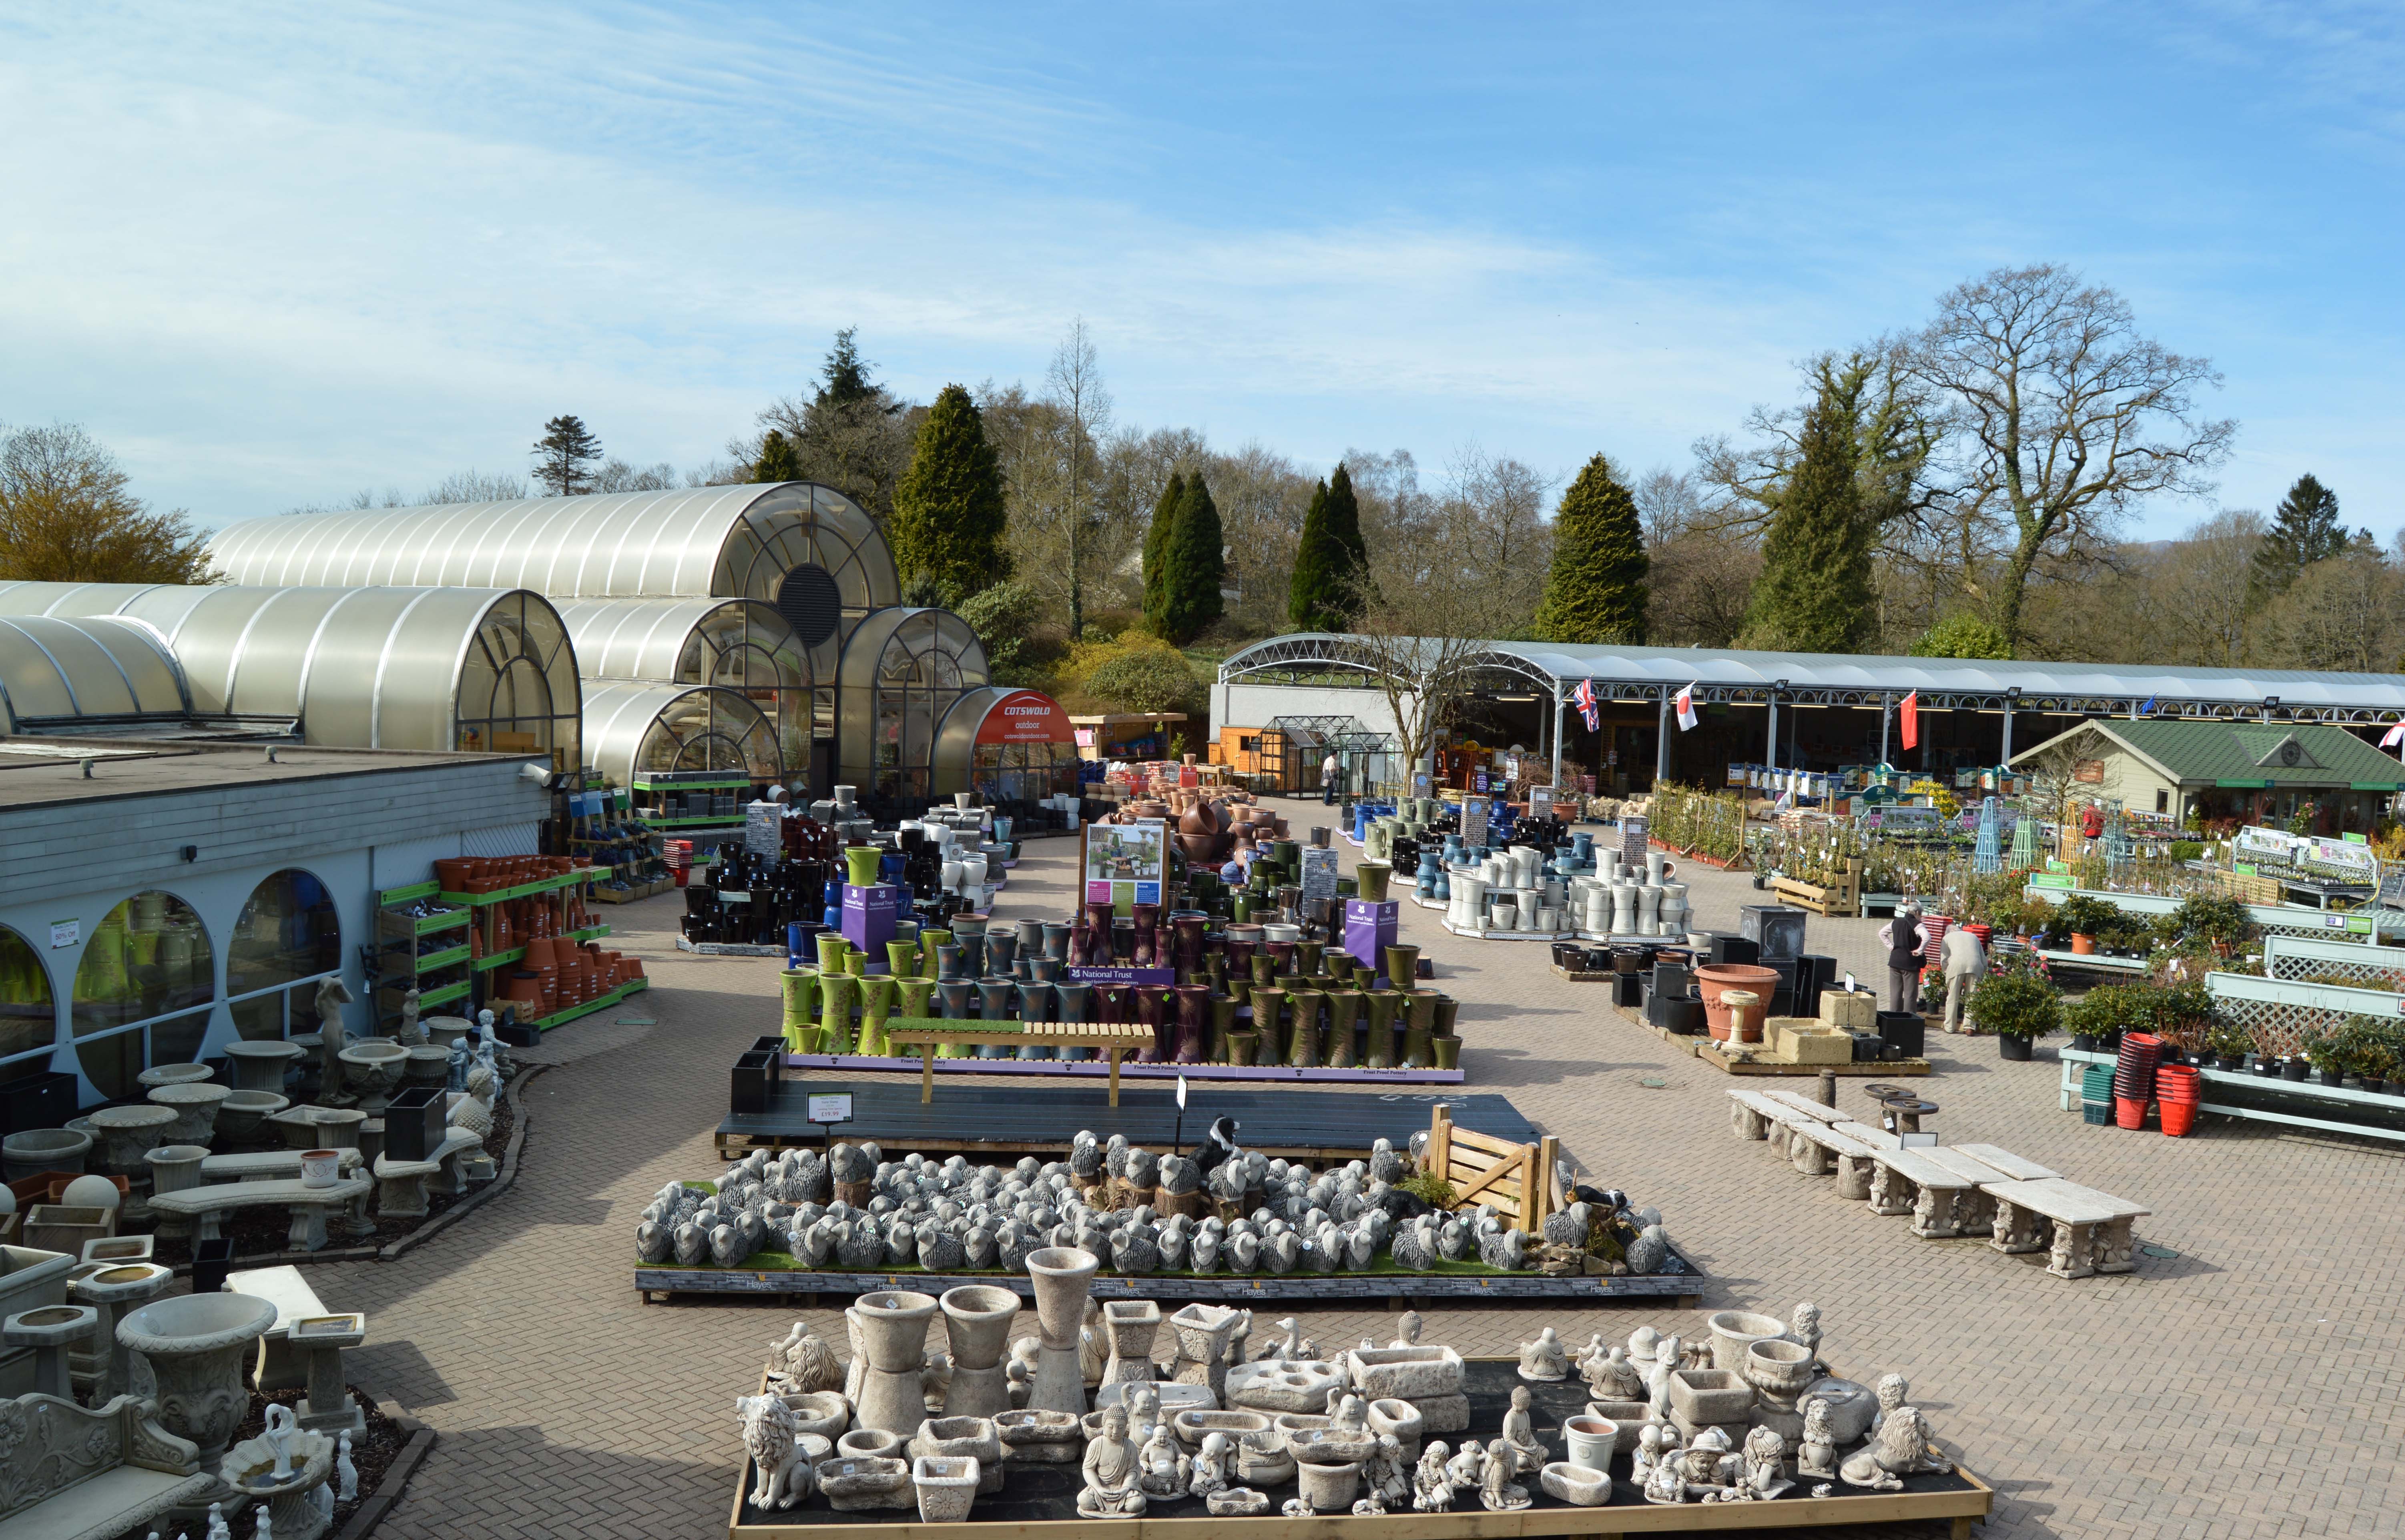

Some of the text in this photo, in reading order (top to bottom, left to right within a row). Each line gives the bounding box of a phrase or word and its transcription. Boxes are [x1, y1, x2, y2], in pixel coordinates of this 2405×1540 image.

[1004, 707, 1050, 716] COTSWOLD
[1082, 970, 1112, 978] National
[747, 1280, 771, 1289] Hayes
[878, 1282, 902, 1291] Hayes
[1116, 1286, 1139, 1295] Hayes
[1242, 1287, 1266, 1297] Hayes
[1470, 1285, 1493, 1294] Hayes
[1591, 1286, 1613, 1294] Hayes
